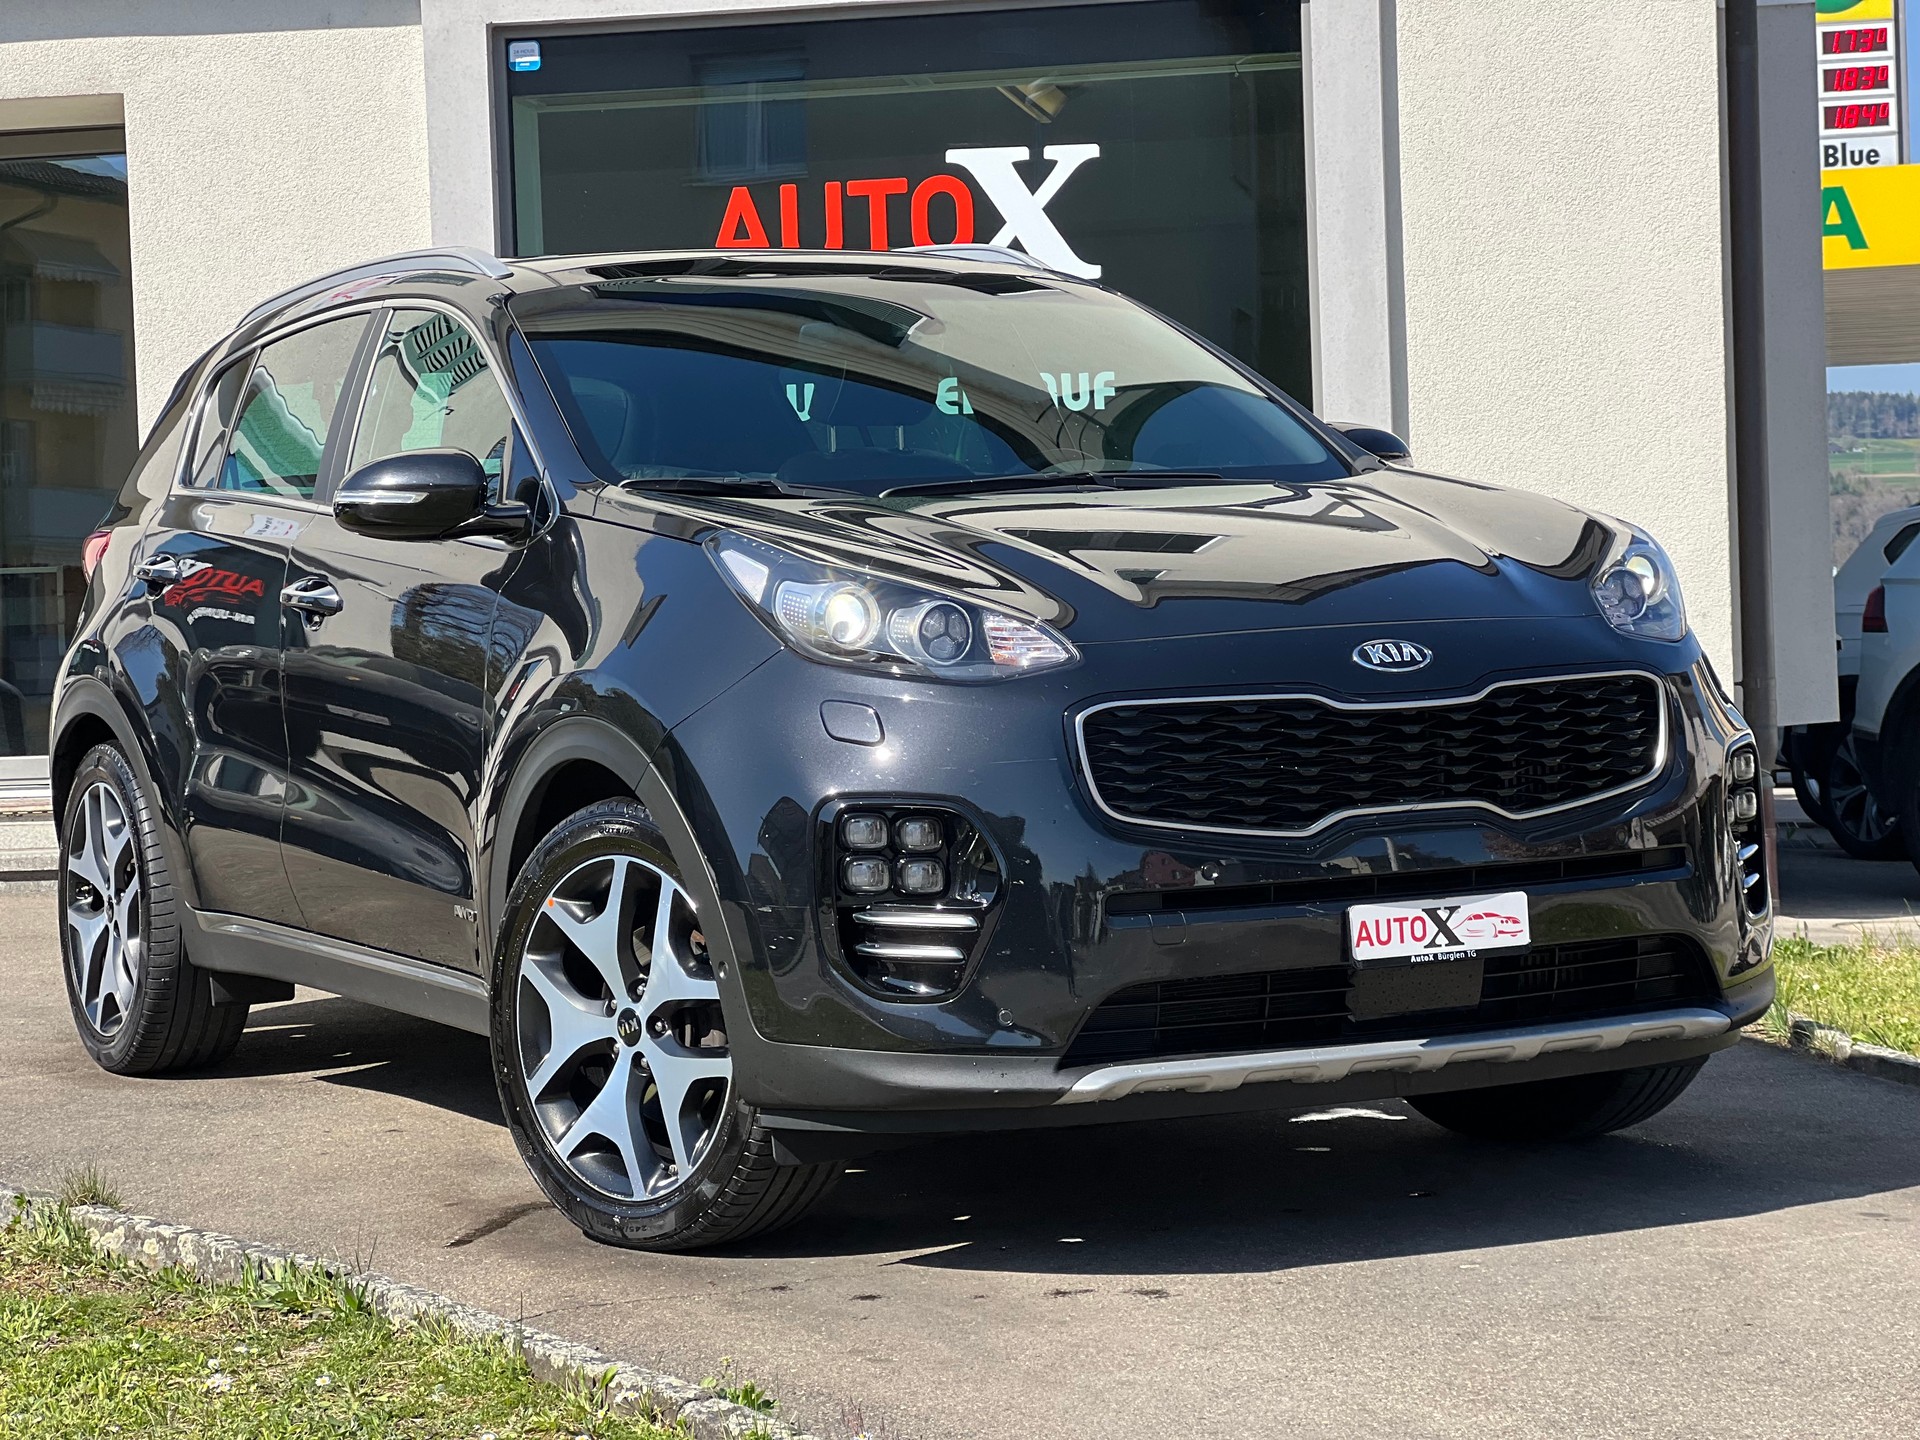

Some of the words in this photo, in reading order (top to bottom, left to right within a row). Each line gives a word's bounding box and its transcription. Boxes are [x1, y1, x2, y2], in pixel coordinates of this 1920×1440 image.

[1823, 142, 1881, 168] Blue
[1363, 643, 1423, 664] KIA
[1410, 953, 1434, 963] AutoX
[1437, 951, 1465, 962] Bürglen
[1466, 949, 1477, 958] TG
[618, 1017, 639, 1037] KIA
